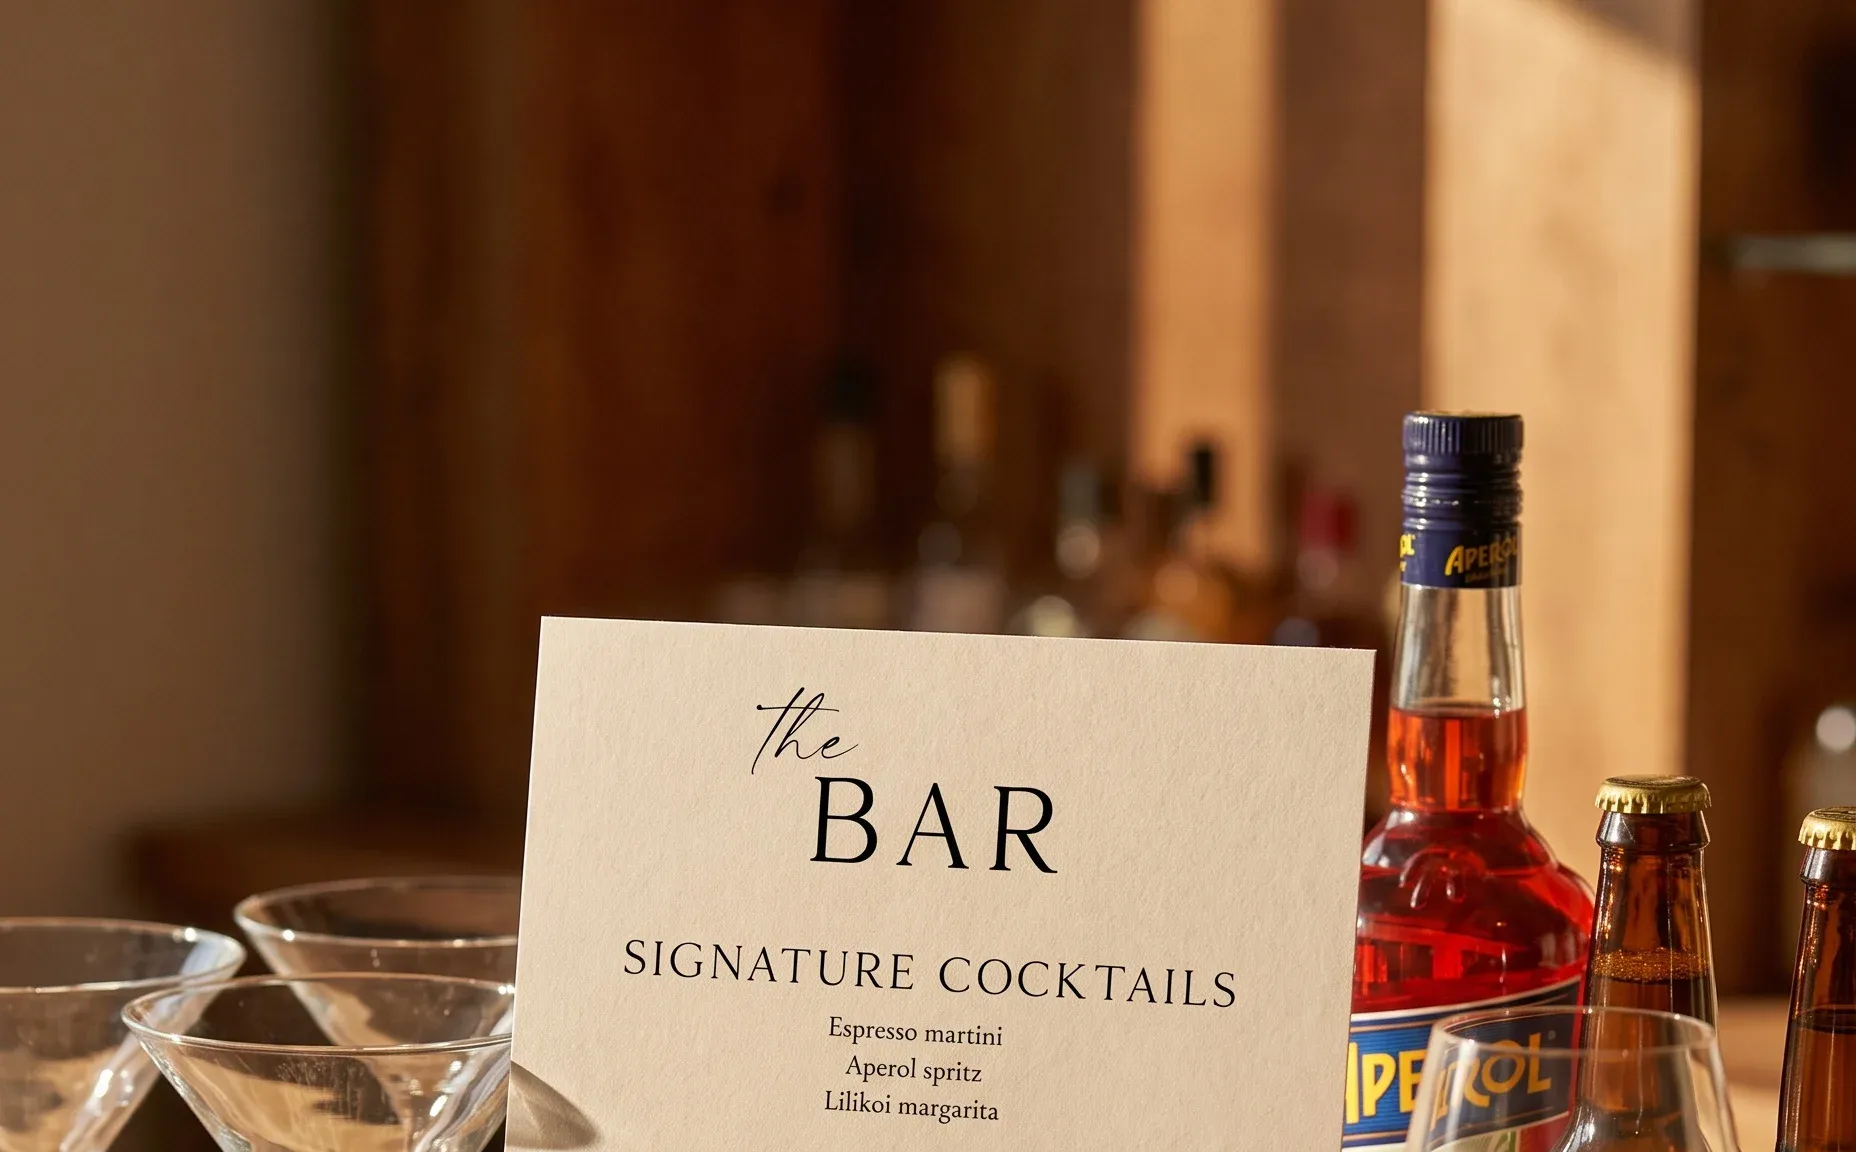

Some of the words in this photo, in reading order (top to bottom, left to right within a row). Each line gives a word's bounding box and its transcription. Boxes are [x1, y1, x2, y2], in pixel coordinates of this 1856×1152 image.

[750, 686, 858, 775] the
[809, 776, 1059, 875] BAR
[623, 938, 914, 990] SIGNATURE
[939, 956, 1237, 1008] COCKTAILS
[828, 1016, 918, 1045] Espresso
[924, 1025, 1003, 1047] martini
[844, 1055, 917, 1083] Aperol
[923, 1061, 982, 1087] spritz
[824, 1090, 891, 1115] Lilikoi
[898, 1099, 999, 1124] margarita
